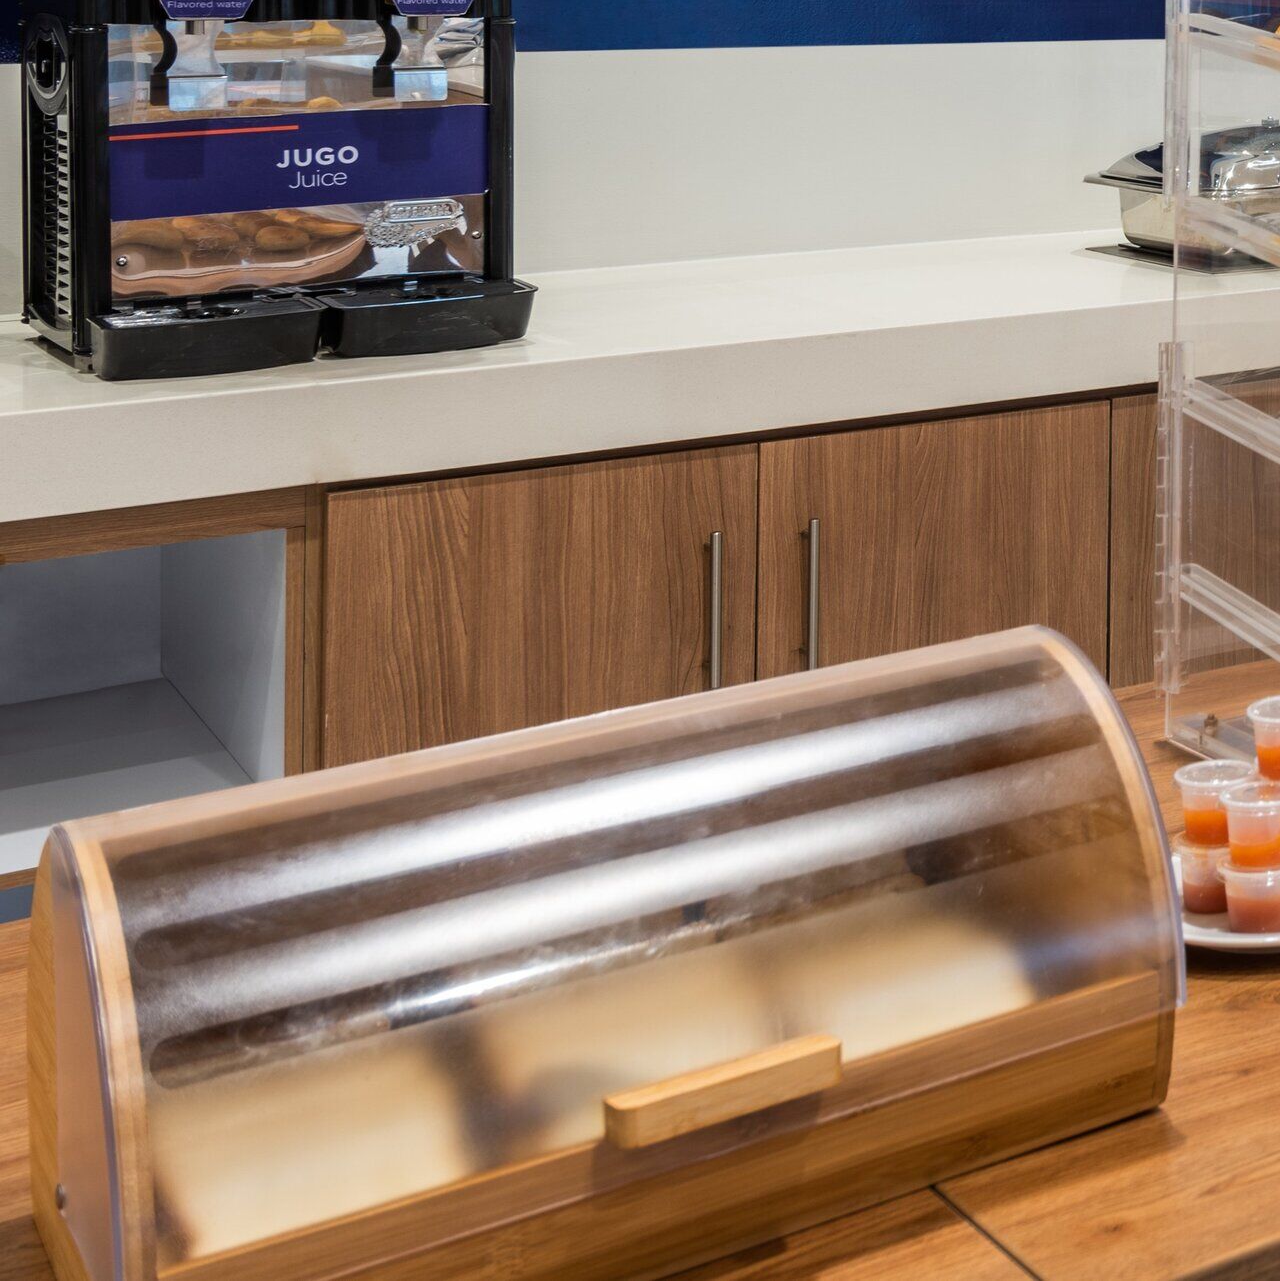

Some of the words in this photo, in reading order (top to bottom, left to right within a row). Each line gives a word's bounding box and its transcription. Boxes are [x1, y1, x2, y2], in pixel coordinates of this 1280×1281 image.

[167, 0, 213, 8] Flavored
[216, 0, 247, 8] water
[276, 145, 359, 168] JUGO
[288, 169, 348, 189] Juice
